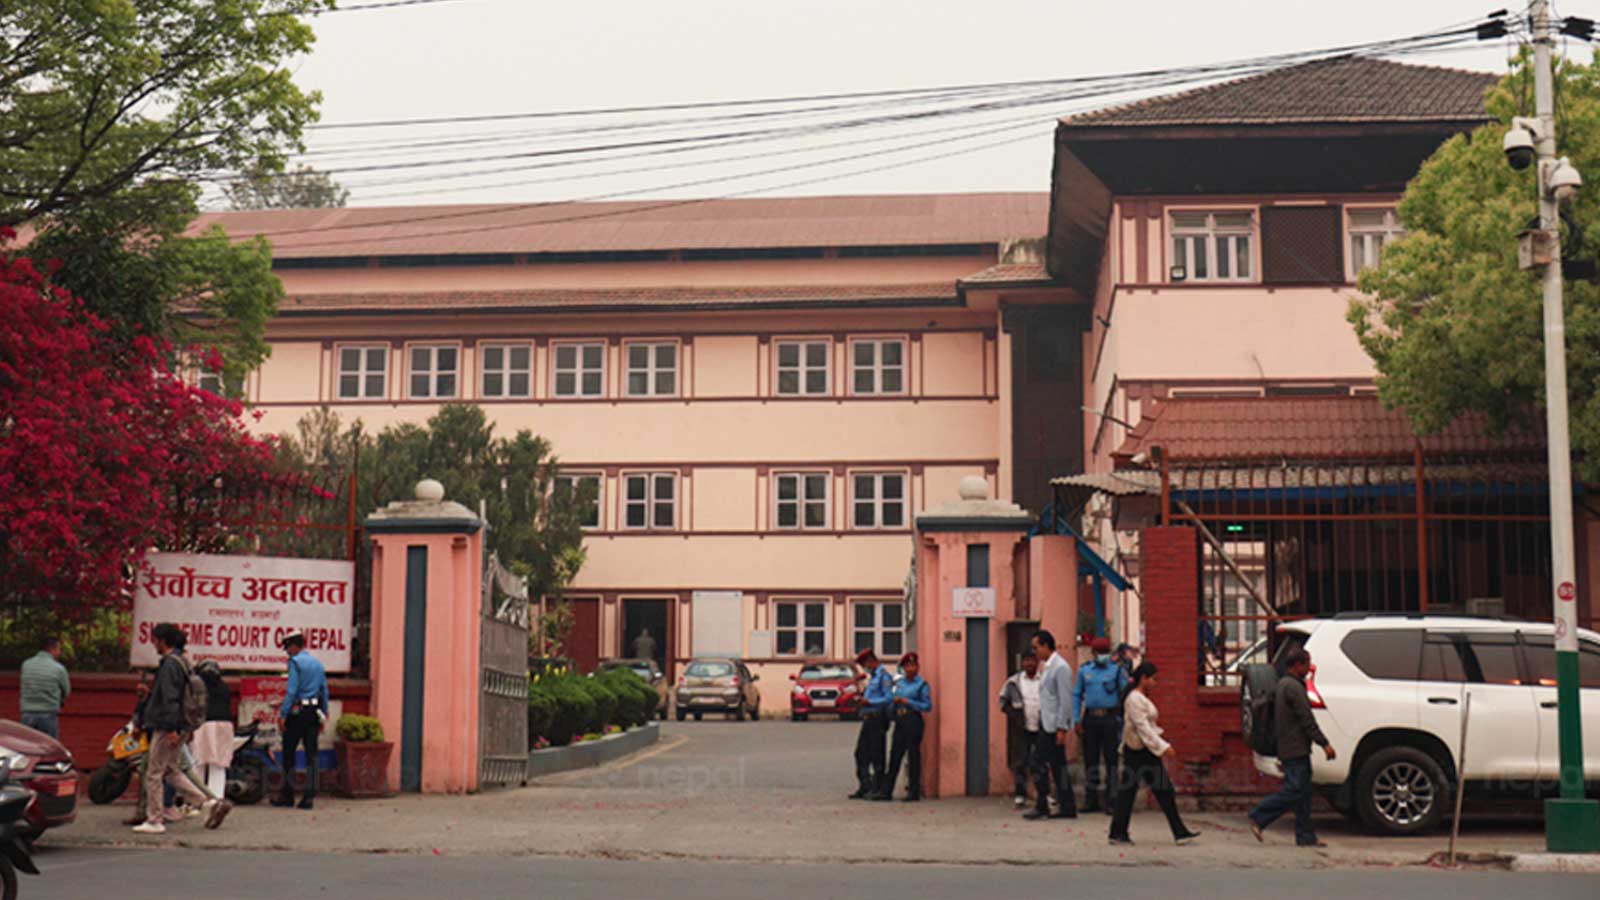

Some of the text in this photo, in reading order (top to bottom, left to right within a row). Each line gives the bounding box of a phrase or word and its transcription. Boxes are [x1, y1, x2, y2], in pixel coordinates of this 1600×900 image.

[143, 567, 348, 604] सर्वोच्च अदालत
[139, 621, 213, 645] SEME
[217, 624, 270, 648] COURT
